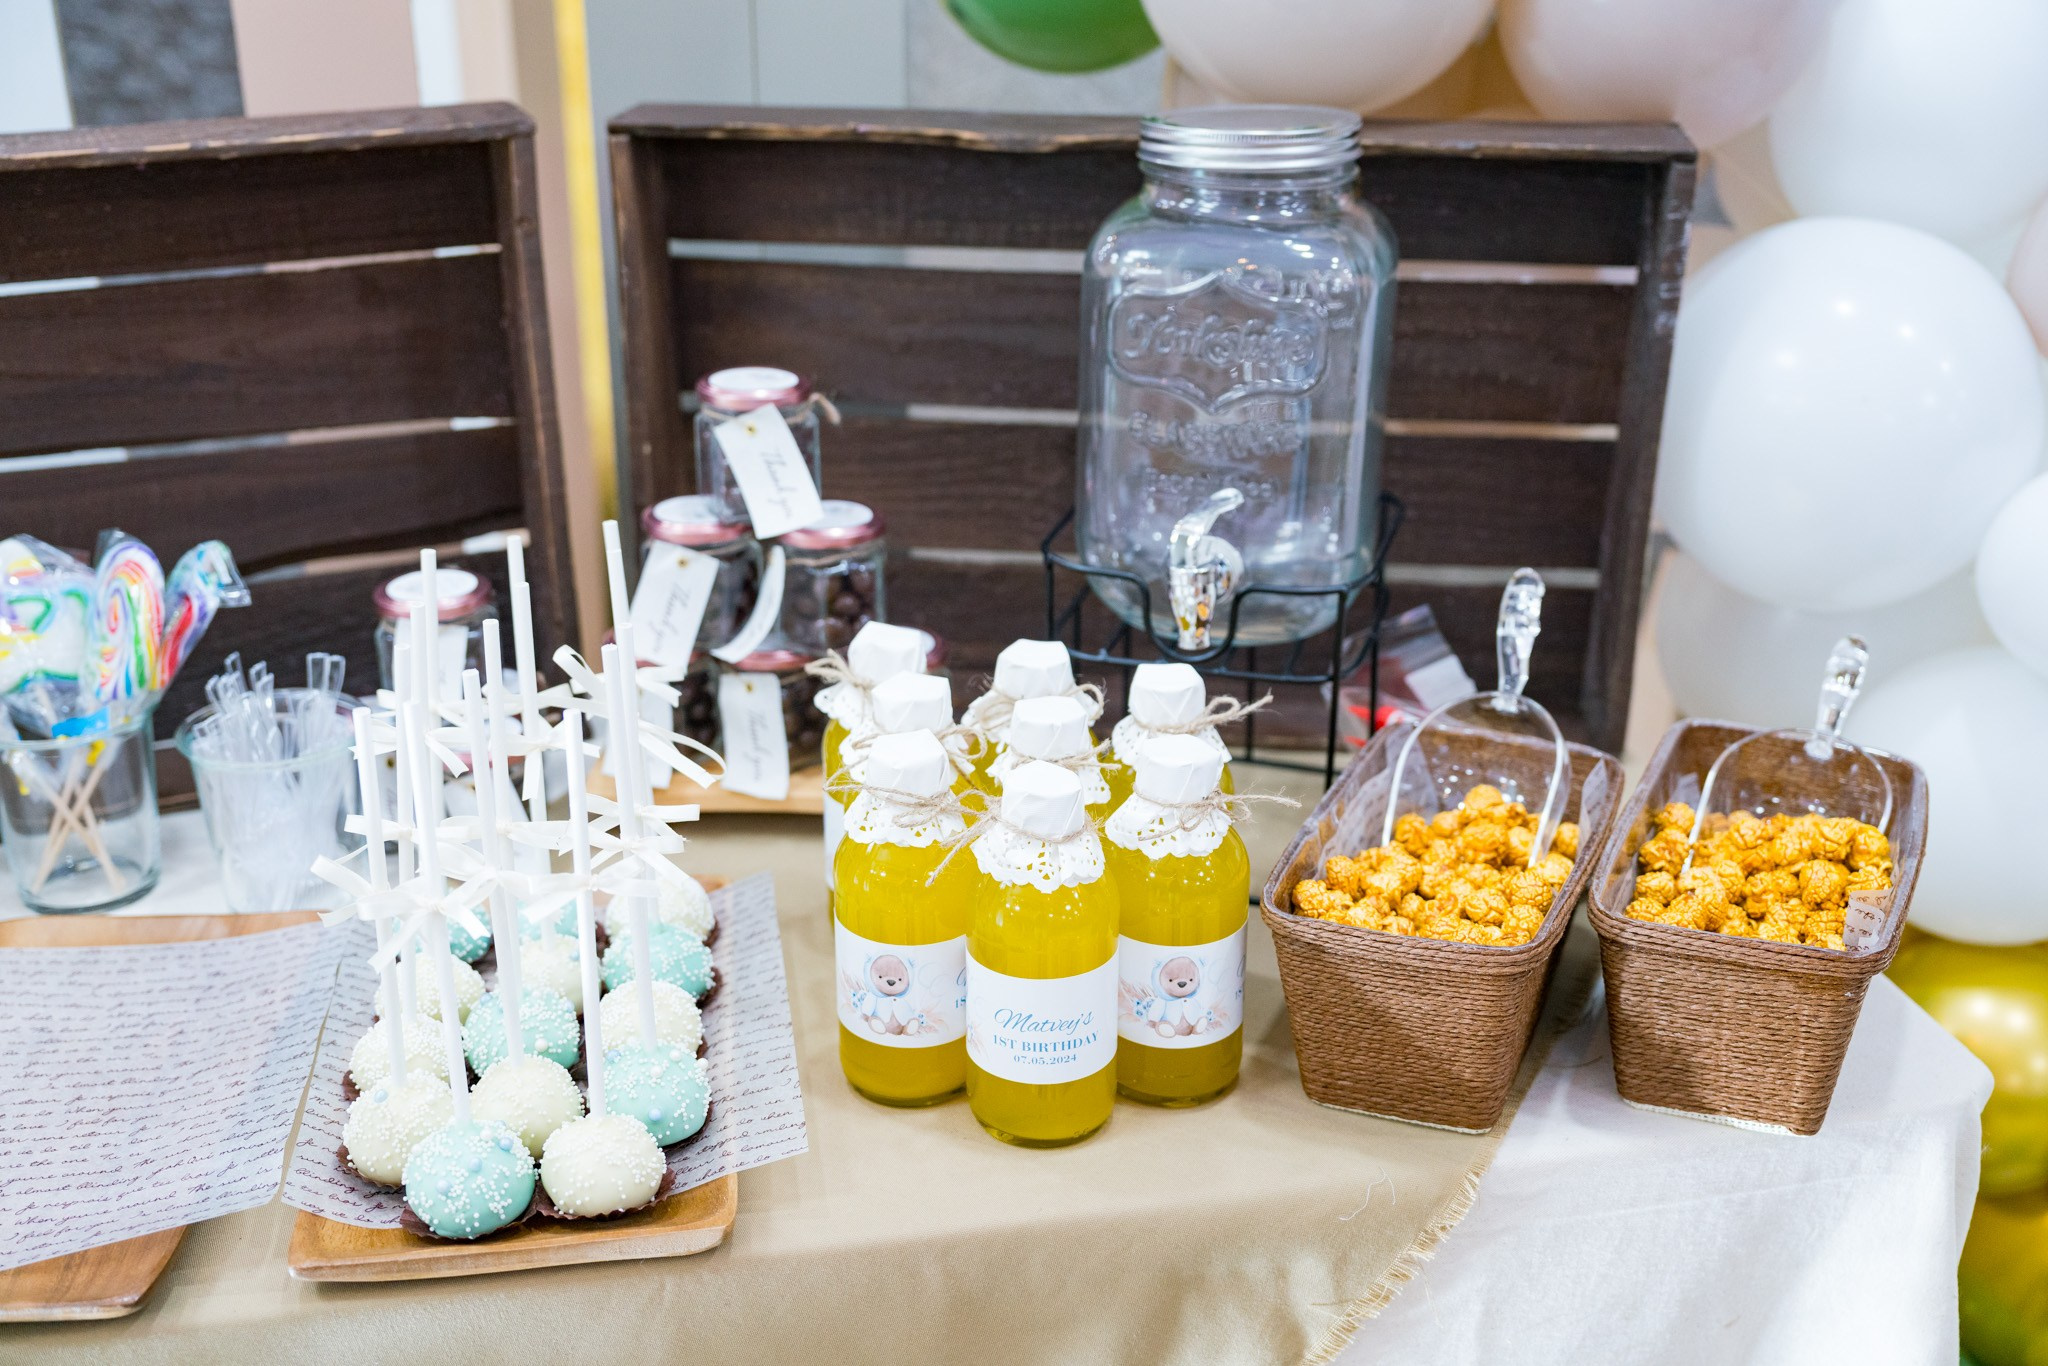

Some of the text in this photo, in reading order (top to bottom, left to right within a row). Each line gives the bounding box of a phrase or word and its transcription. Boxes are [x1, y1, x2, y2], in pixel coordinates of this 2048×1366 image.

[994, 1008, 1095, 1036] Matvey's
[993, 1030, 1099, 1053] 1ST BIRTHDAY
[1013, 1053, 1077, 1066] 07.05.2024
[295, 1167, 359, 1194] blinding
